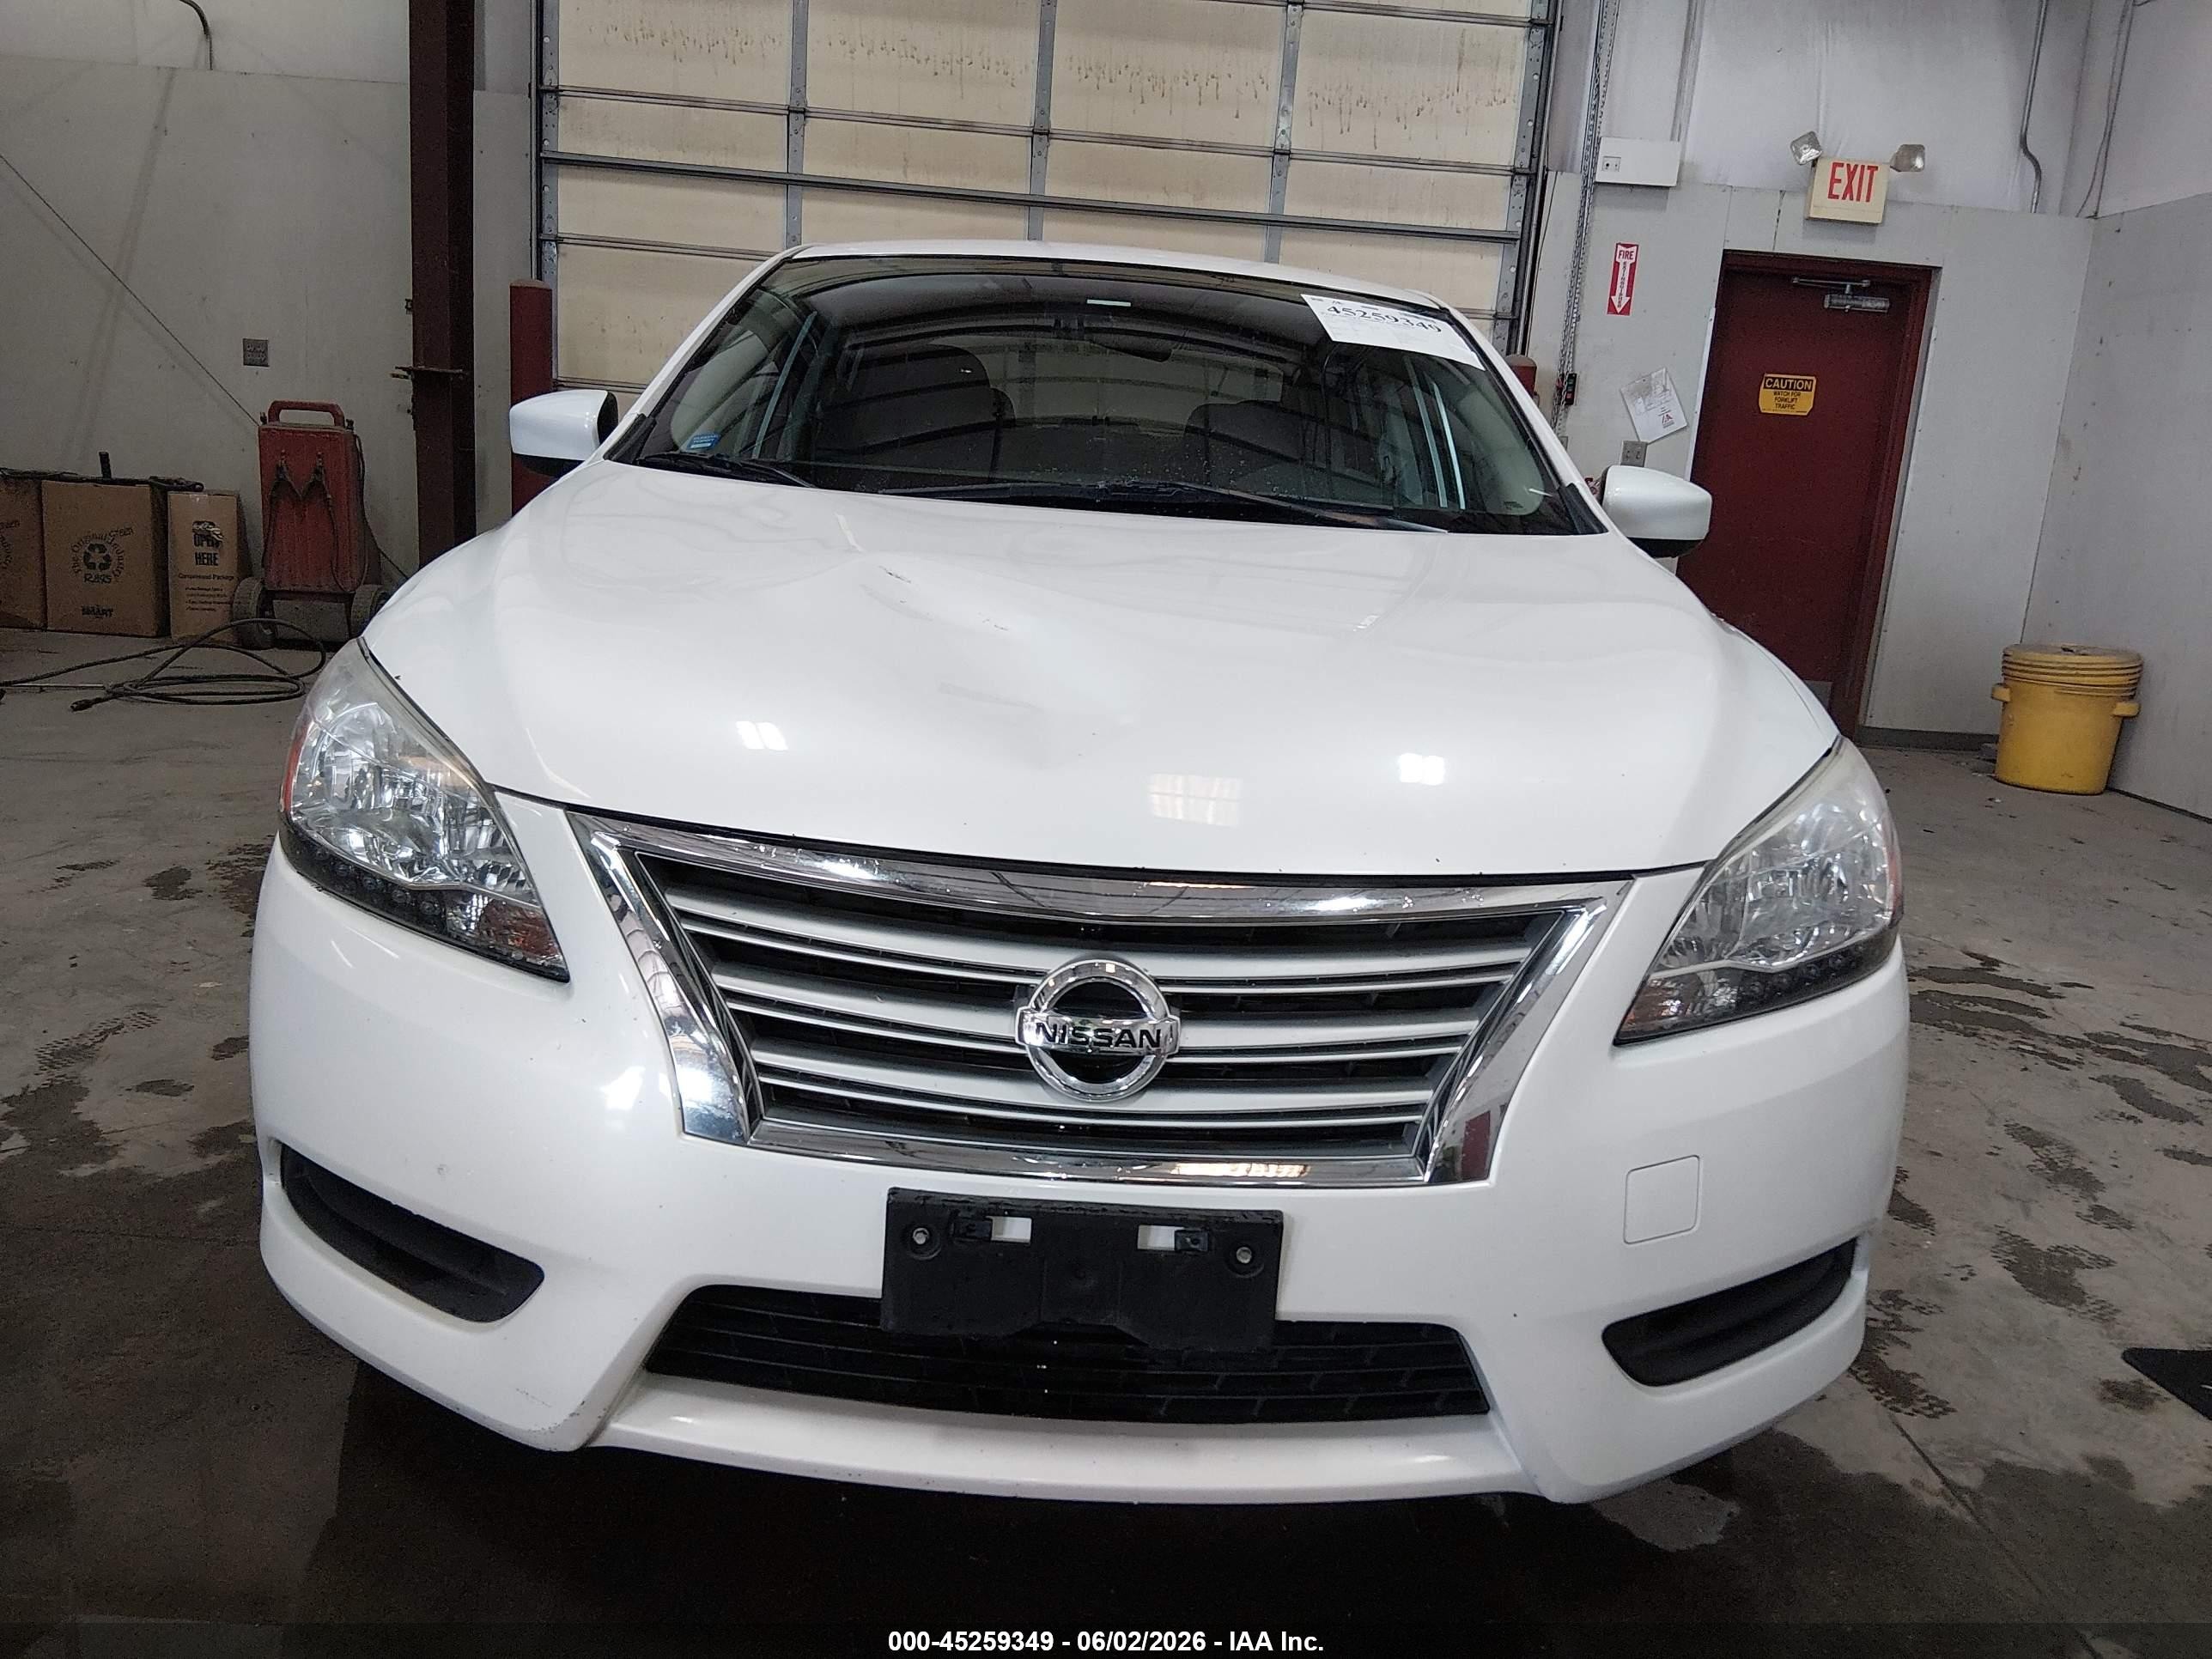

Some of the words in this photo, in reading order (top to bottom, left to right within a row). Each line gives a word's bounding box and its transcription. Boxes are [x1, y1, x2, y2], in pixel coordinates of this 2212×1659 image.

[1827, 161, 1879, 203] EXIT
[1618, 250, 1634, 260] FIRE
[1327, 306, 1442, 333] 45259349
[1765, 378, 1813, 391] CAUTION
[193, 533, 221, 548] OPEN
[194, 552, 219, 566] HERE
[1034, 1022, 1162, 1048] NISSAN
